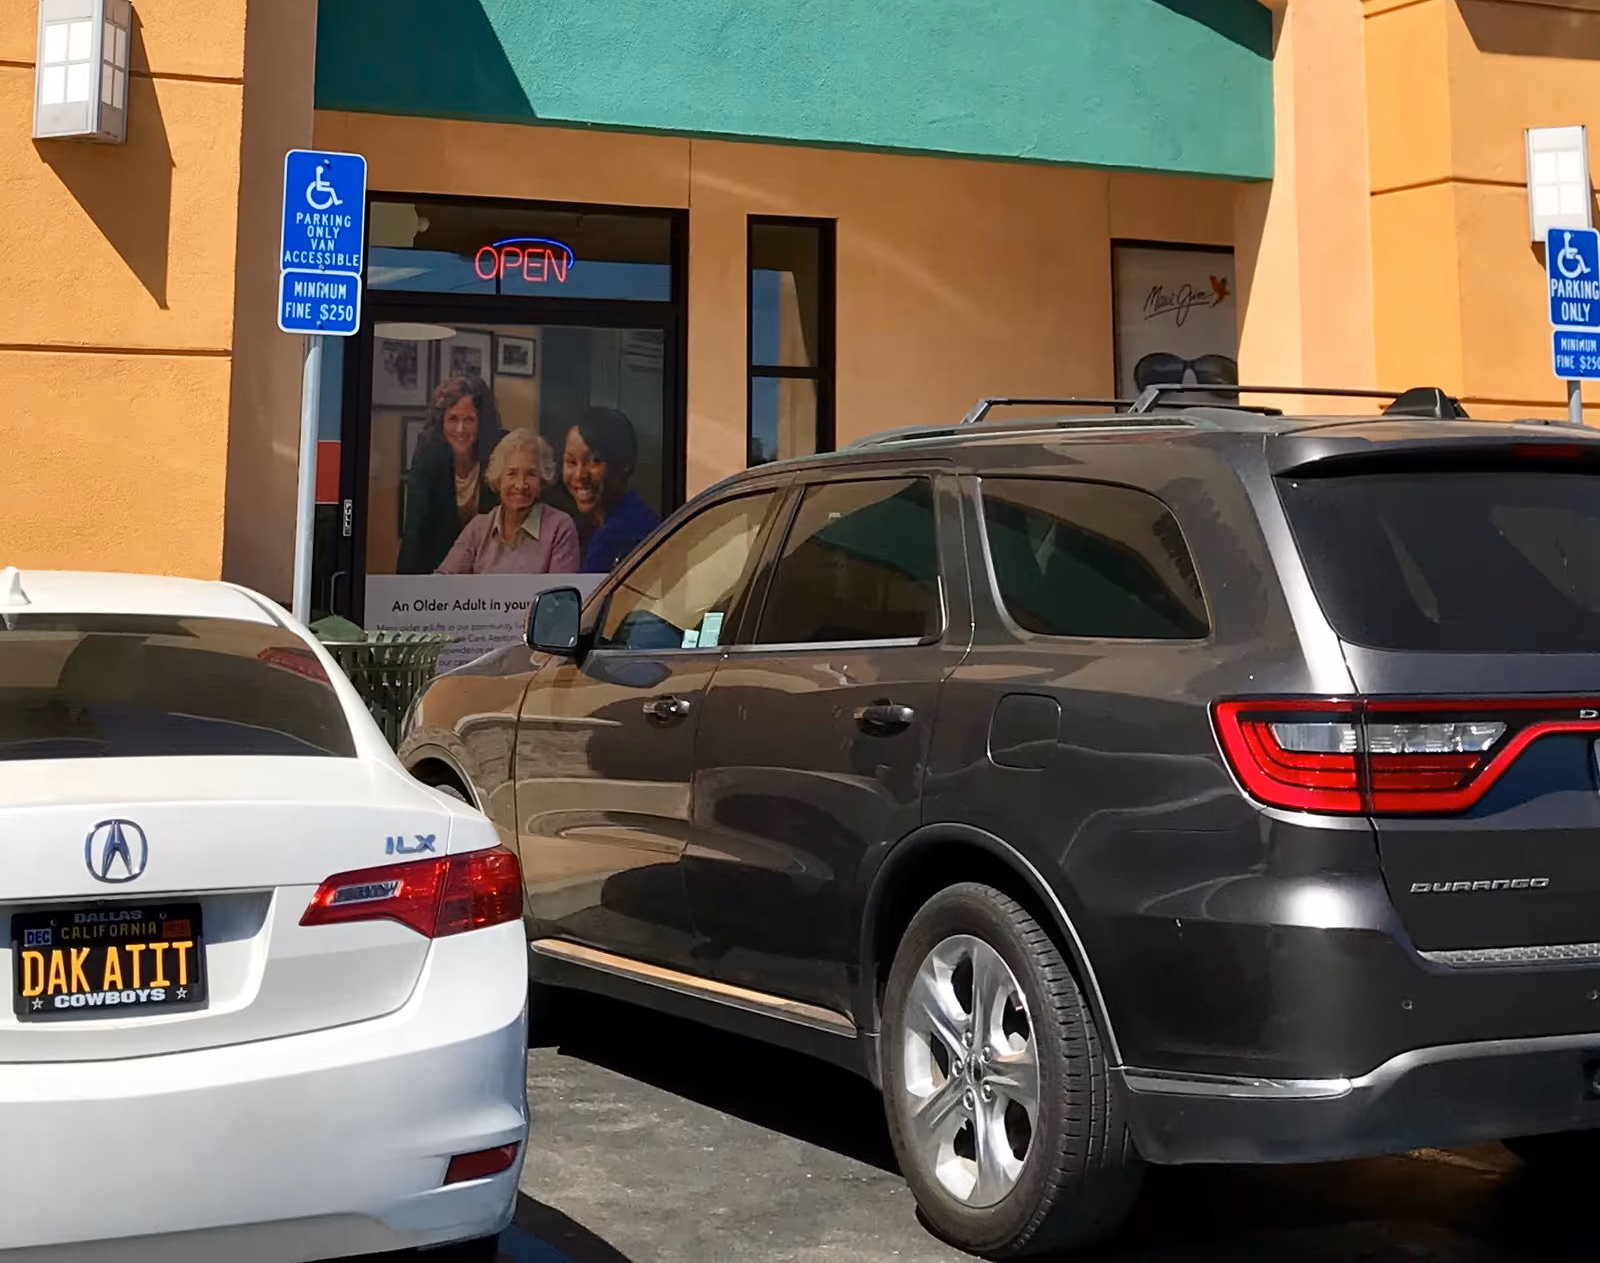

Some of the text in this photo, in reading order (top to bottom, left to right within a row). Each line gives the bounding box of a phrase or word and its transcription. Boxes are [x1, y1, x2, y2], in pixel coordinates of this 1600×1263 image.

[296, 212, 352, 228] PARKING
[307, 225, 340, 240] ONLY
[310, 238, 335, 252] VAN
[284, 250, 360, 267] ACCESSIBLE
[474, 246, 568, 283] OPEN
[294, 281, 347, 300] MINIMUM
[1551, 278, 1599, 300] PARKING
[285, 301, 354, 323] FINE $250
[1561, 301, 1591, 322] ONLY
[1561, 337, 1597, 352] MINIMUM
[1556, 354, 1575, 369] FINE
[391, 600, 409, 612] An
[413, 599, 449, 612] Older
[452, 598, 486, 611] Adult
[490, 598, 501, 611] in
[385, 833, 436, 855] ILX
[1410, 877, 1550, 894] DURANGO
[74, 910, 143, 924] DALLAS
[27, 929, 51, 945] DEC
[61, 921, 157, 940] CALIFORNIA
[21, 941, 193, 997] DAK ATIT
[54, 988, 166, 1008] COWBOYS
